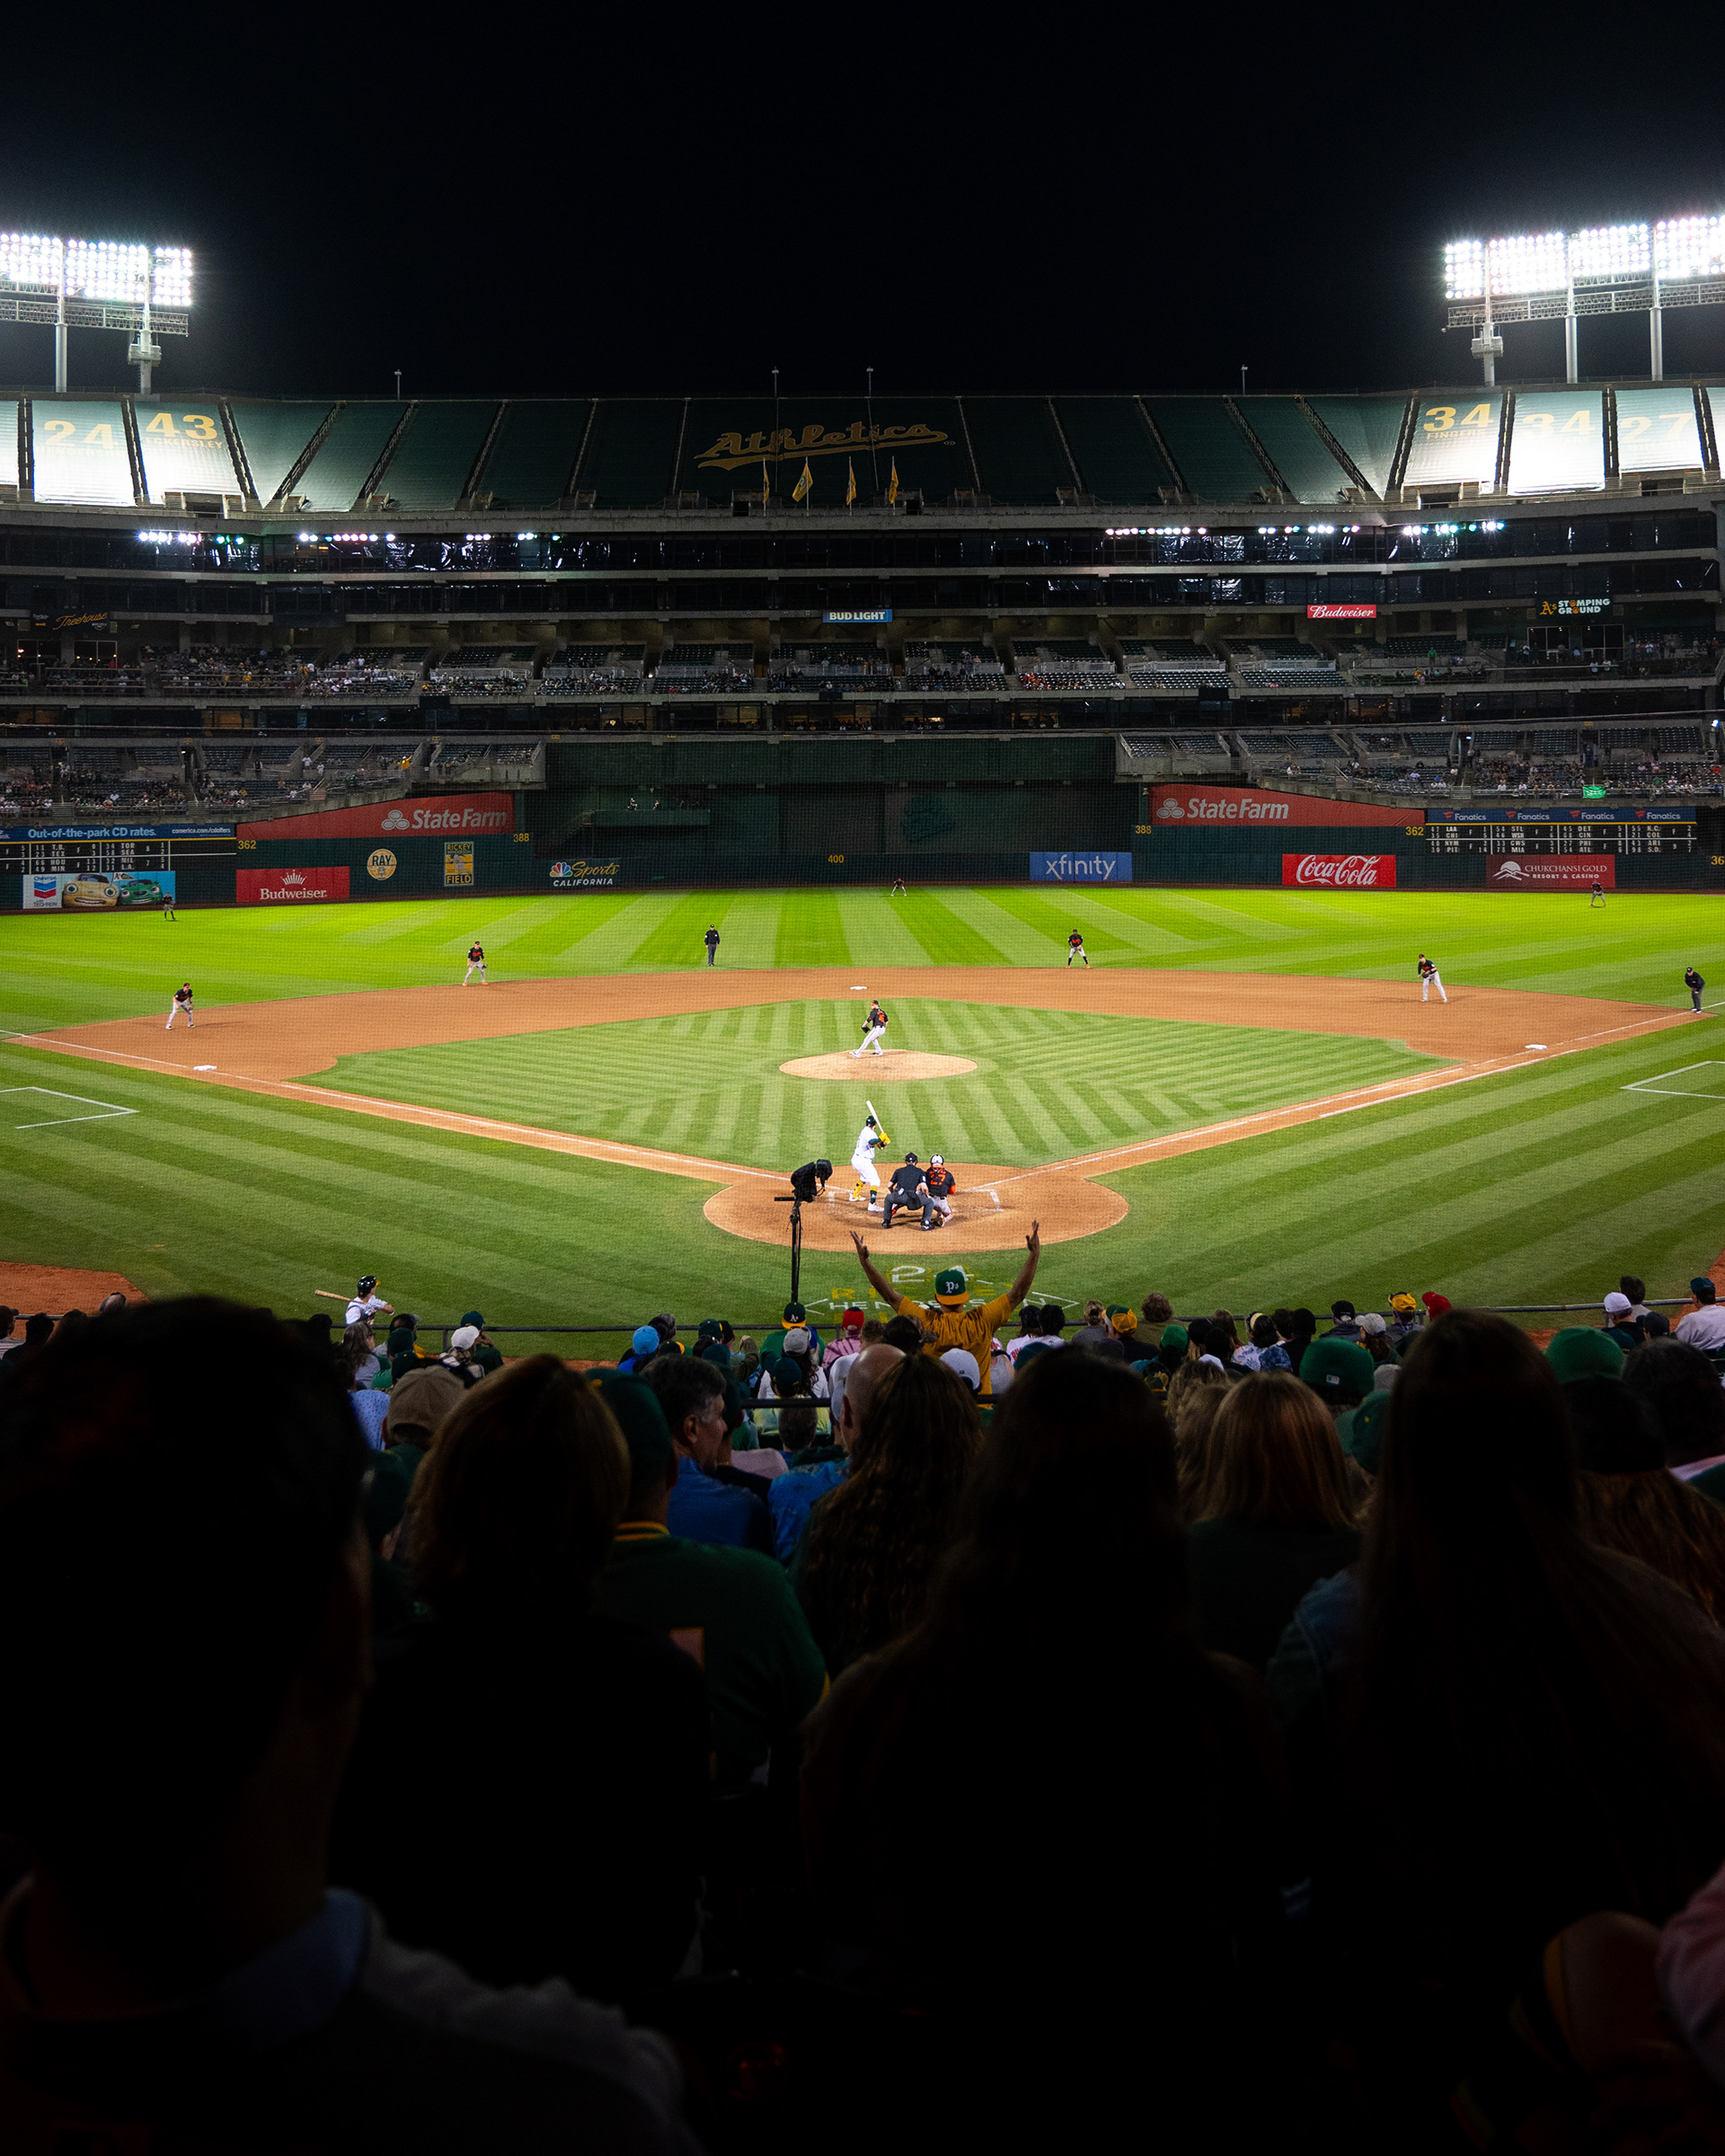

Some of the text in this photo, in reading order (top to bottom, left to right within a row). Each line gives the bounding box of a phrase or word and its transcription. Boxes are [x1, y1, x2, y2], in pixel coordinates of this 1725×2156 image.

[1424, 403, 1494, 431] 34
[146, 413, 217, 439] 43
[1523, 411, 1596, 436] 34
[1621, 413, 1694, 443] 27
[44, 420, 119, 449] 24
[1427, 429, 1485, 439] FINGERS
[146, 437, 223, 448] ECKERSLEY
[694, 421, 939, 460] Athletics
[1310, 605, 1374, 618] Budweiser
[1540, 601, 1557, 615] A's
[52, 613, 108, 630] Treehouse
[829, 612, 885, 621] BUD LIGHT
[1581, 812, 1614, 820] Fanatics
[1647, 812, 1681, 820] Fanatics
[28, 827, 156, 839] Out-of-the-park CD rates.
[1136, 826, 1151, 835] 388
[1405, 826, 1424, 836] 362
[514, 834, 529, 843] 388
[238, 841, 256, 850] 362
[372, 855, 392, 866] RAY
[827, 855, 845, 864] 400
[571, 862, 621, 878] Sports
[1046, 854, 1116, 880] xfinity
[1296, 855, 1381, 885] Coca-Cola
[447, 875, 472, 884] FIELD
[553, 878, 614, 888] CALIFORNIA
[261, 888, 327, 900] Budweiser
